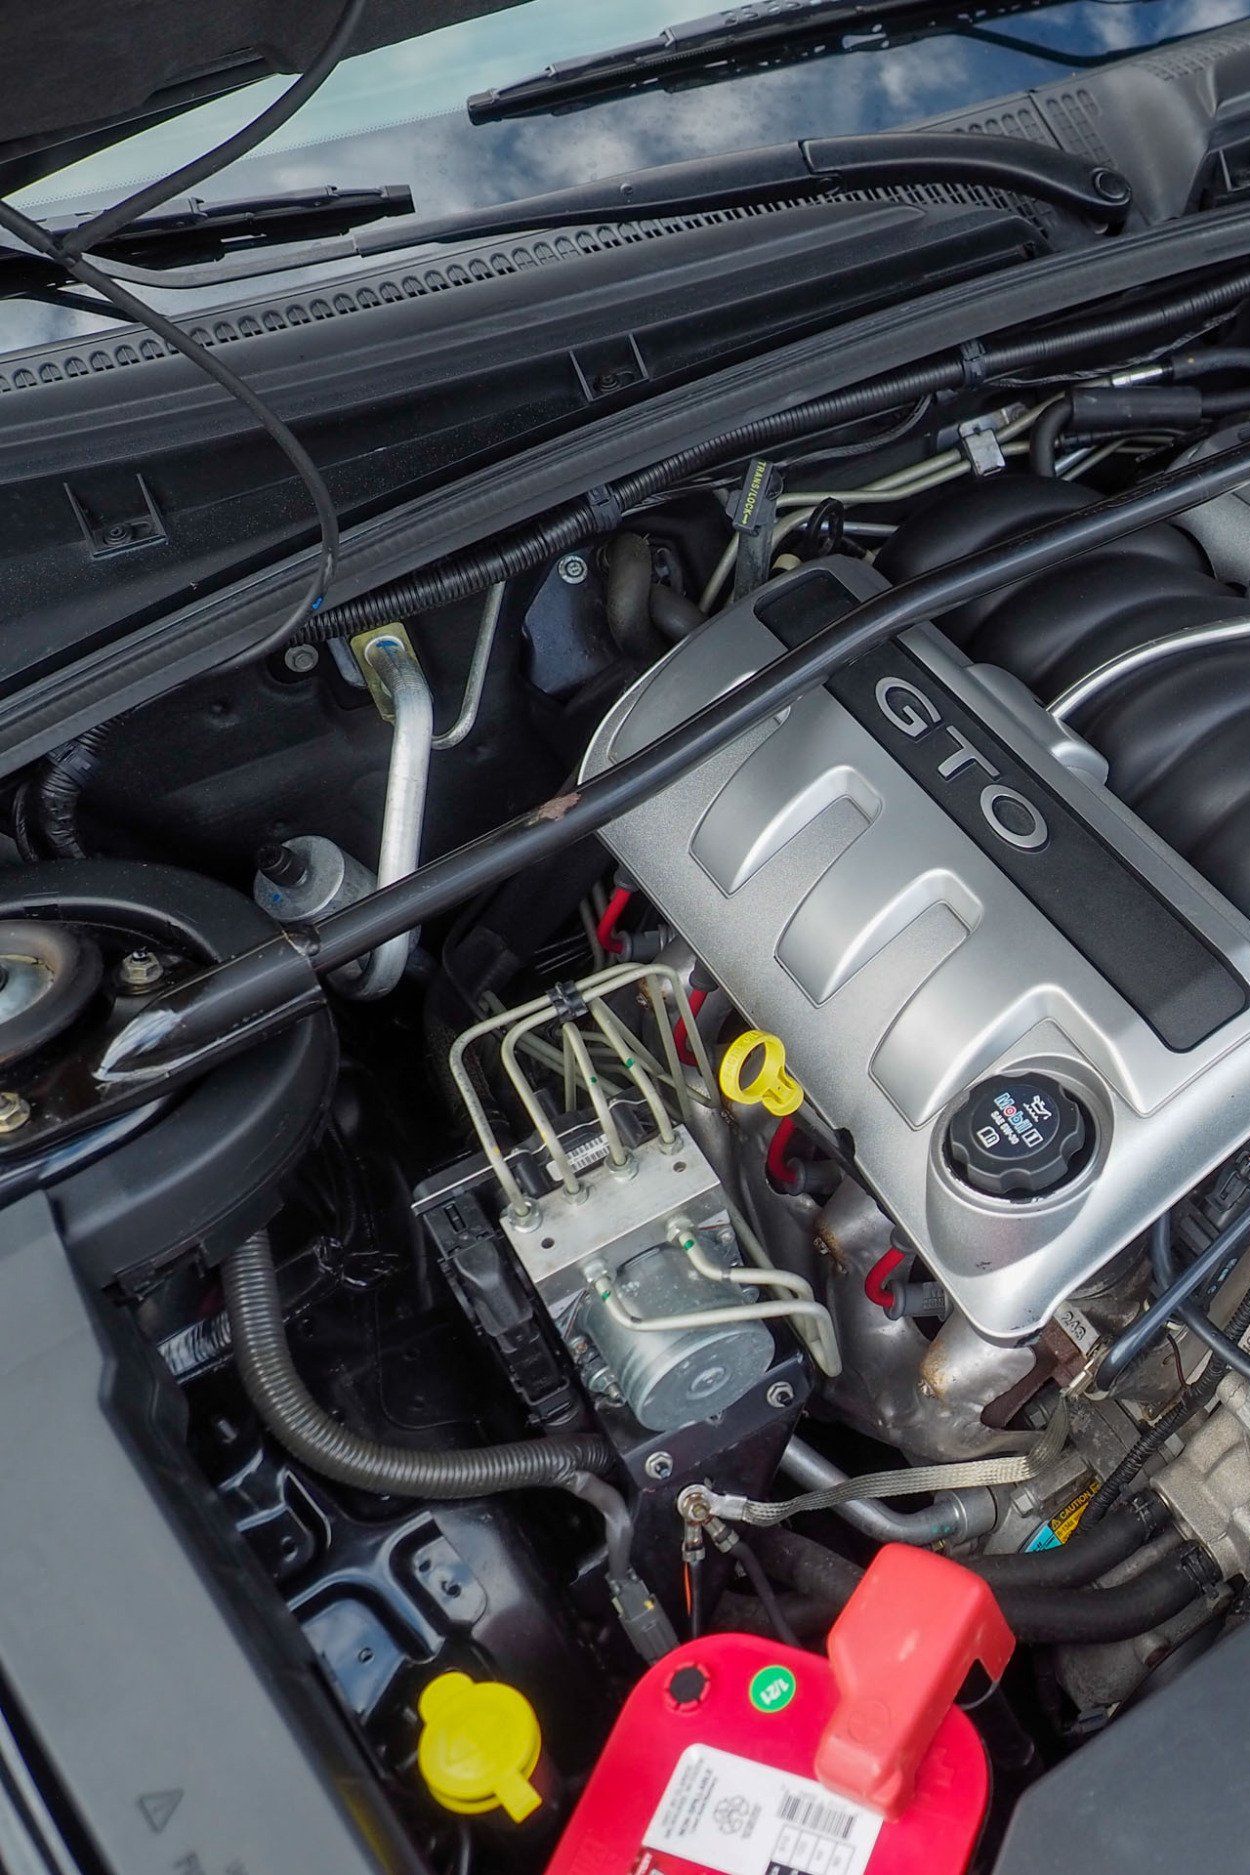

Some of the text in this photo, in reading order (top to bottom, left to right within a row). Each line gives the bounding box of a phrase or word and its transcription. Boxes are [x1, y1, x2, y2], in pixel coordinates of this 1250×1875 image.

[743, 460, 766, 514] TRANS/LOCK
[875, 676, 1048, 849] GTO
[990, 1109, 1004, 1125] SAE
[994, 1092, 1033, 1133] Mobil
[1060, 1491, 1091, 1519] CAUTION
